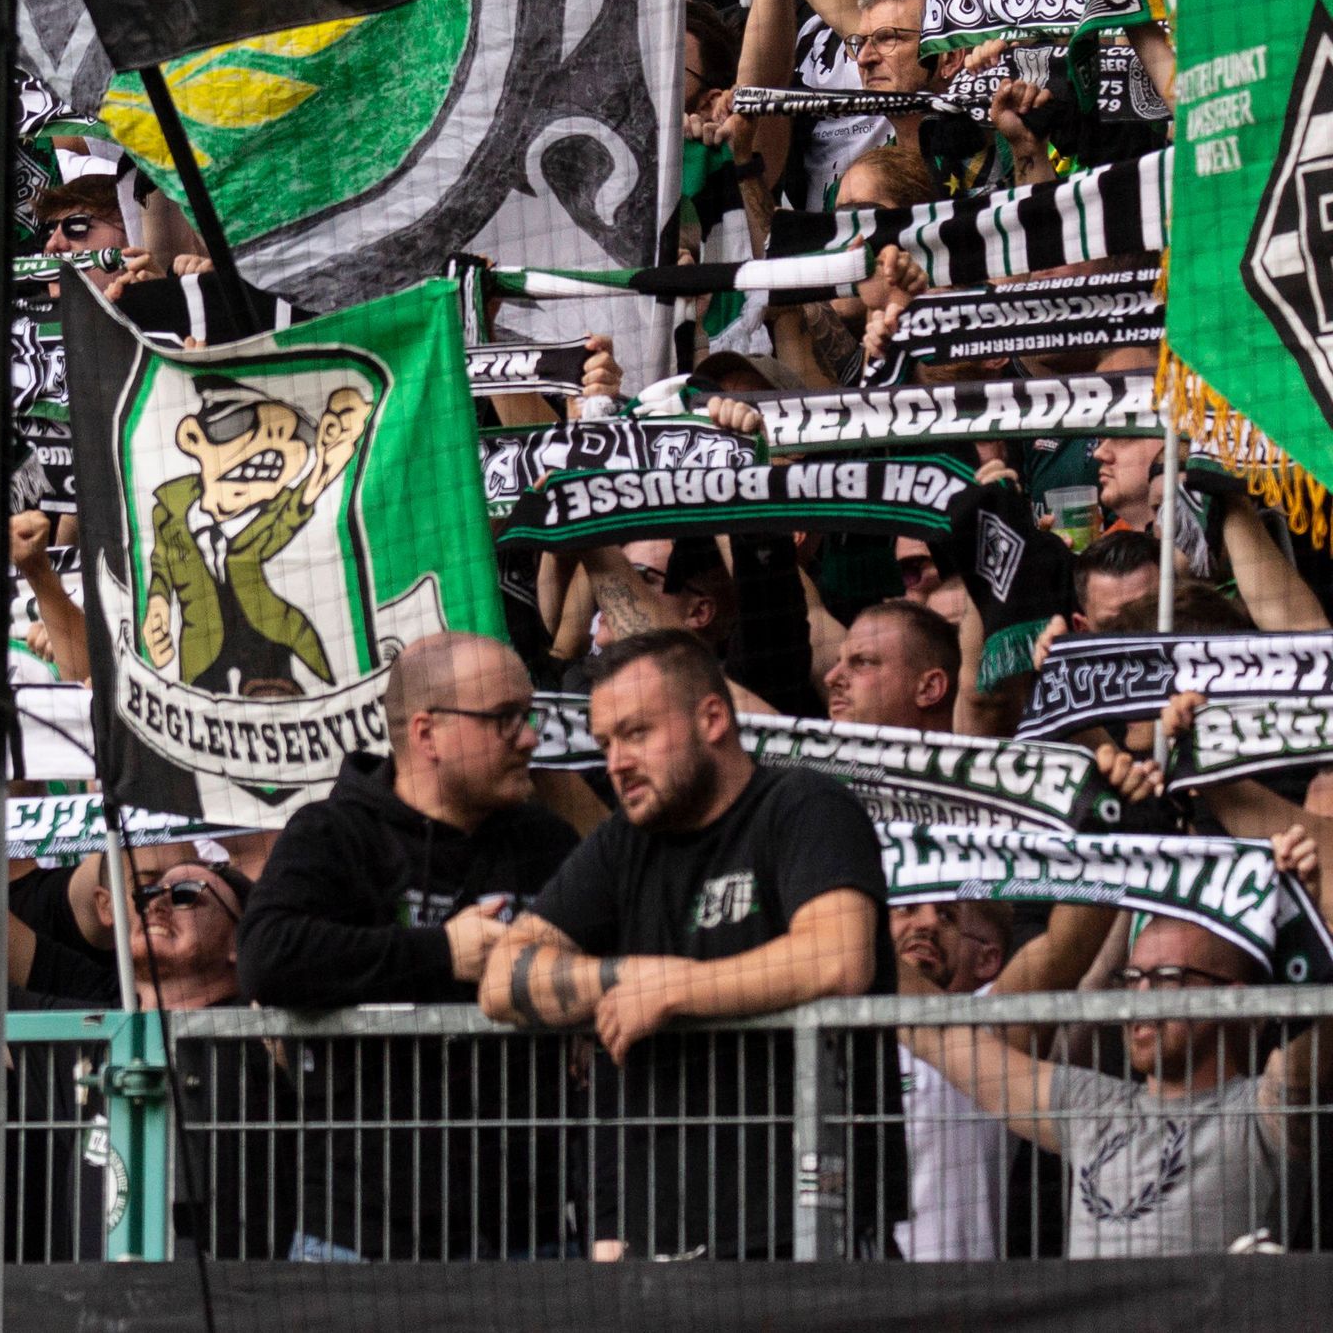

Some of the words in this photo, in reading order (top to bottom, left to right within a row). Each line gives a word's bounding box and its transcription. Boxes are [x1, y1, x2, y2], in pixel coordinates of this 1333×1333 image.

[1194, 135, 1241, 177] WELT
[949, 333, 1064, 357] NIEDERRHEIN
[788, 465, 874, 500] BIN
[127, 679, 390, 765] BEGLEITSERVIC
